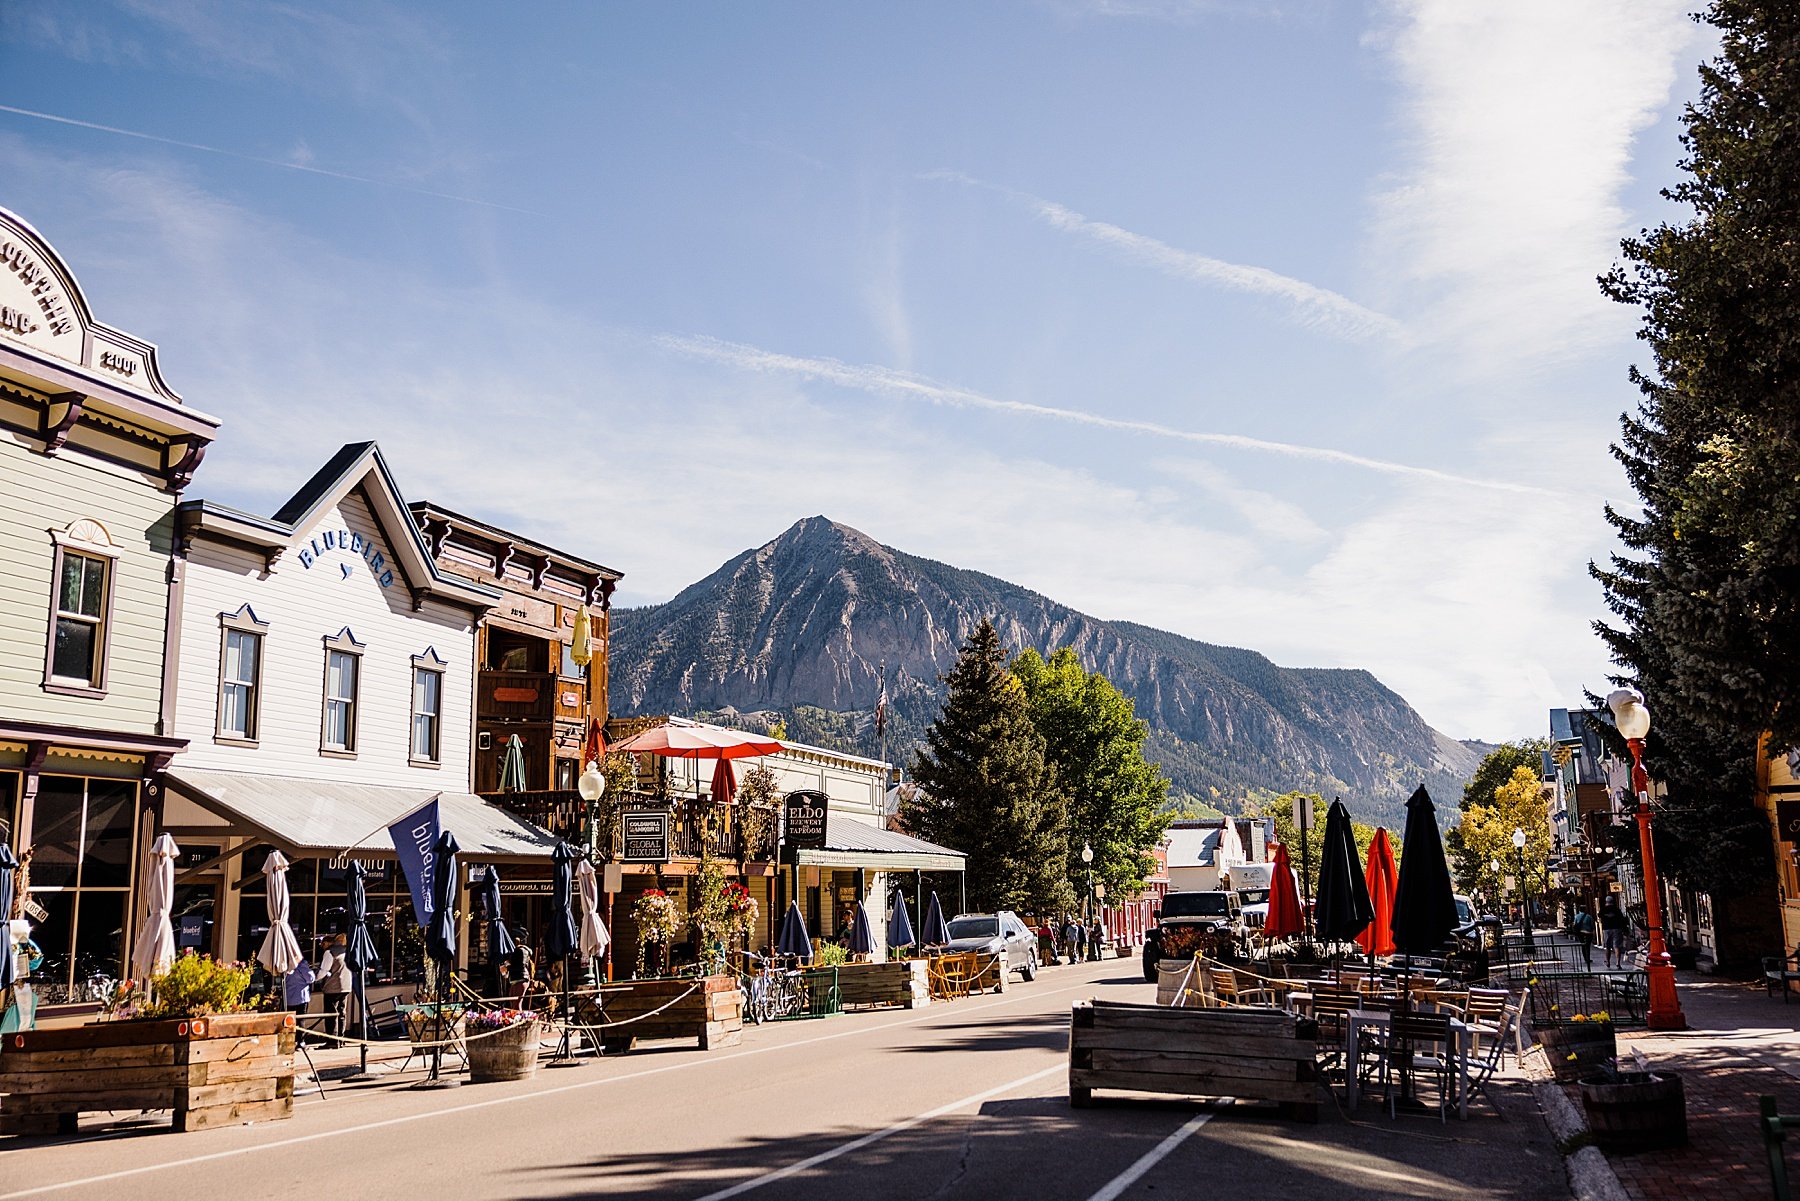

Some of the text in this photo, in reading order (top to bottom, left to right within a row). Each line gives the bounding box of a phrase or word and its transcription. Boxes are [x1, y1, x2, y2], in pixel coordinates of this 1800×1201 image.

[101, 351, 137, 377] 2000
[298, 529, 394, 588] BLUEBIRD
[789, 807, 824, 819] ELDO
[630, 840, 661, 849] GLOBAL
[628, 848, 662, 857] LUXURY
[328, 858, 385, 870] blubird
[25, 901, 48, 921] LOSED
